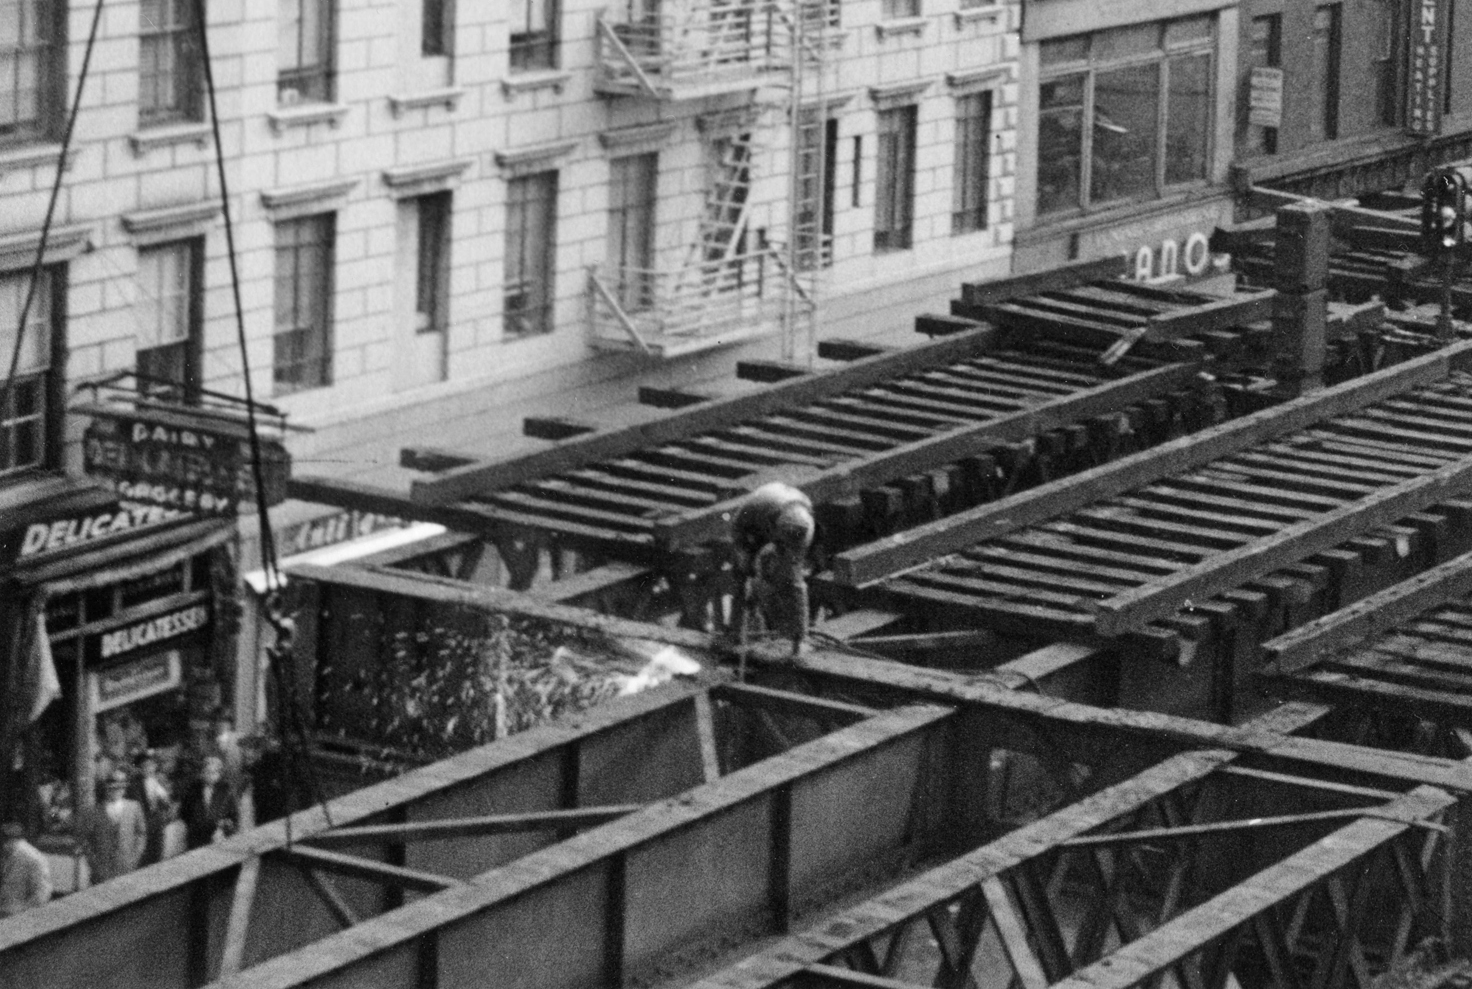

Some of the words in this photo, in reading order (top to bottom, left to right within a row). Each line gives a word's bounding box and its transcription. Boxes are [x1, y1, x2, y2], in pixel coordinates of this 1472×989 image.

[1426, 45, 1438, 131] SUPPLIES
[132, 422, 215, 449] DAIRY
[118, 480, 229, 511] GROCERY
